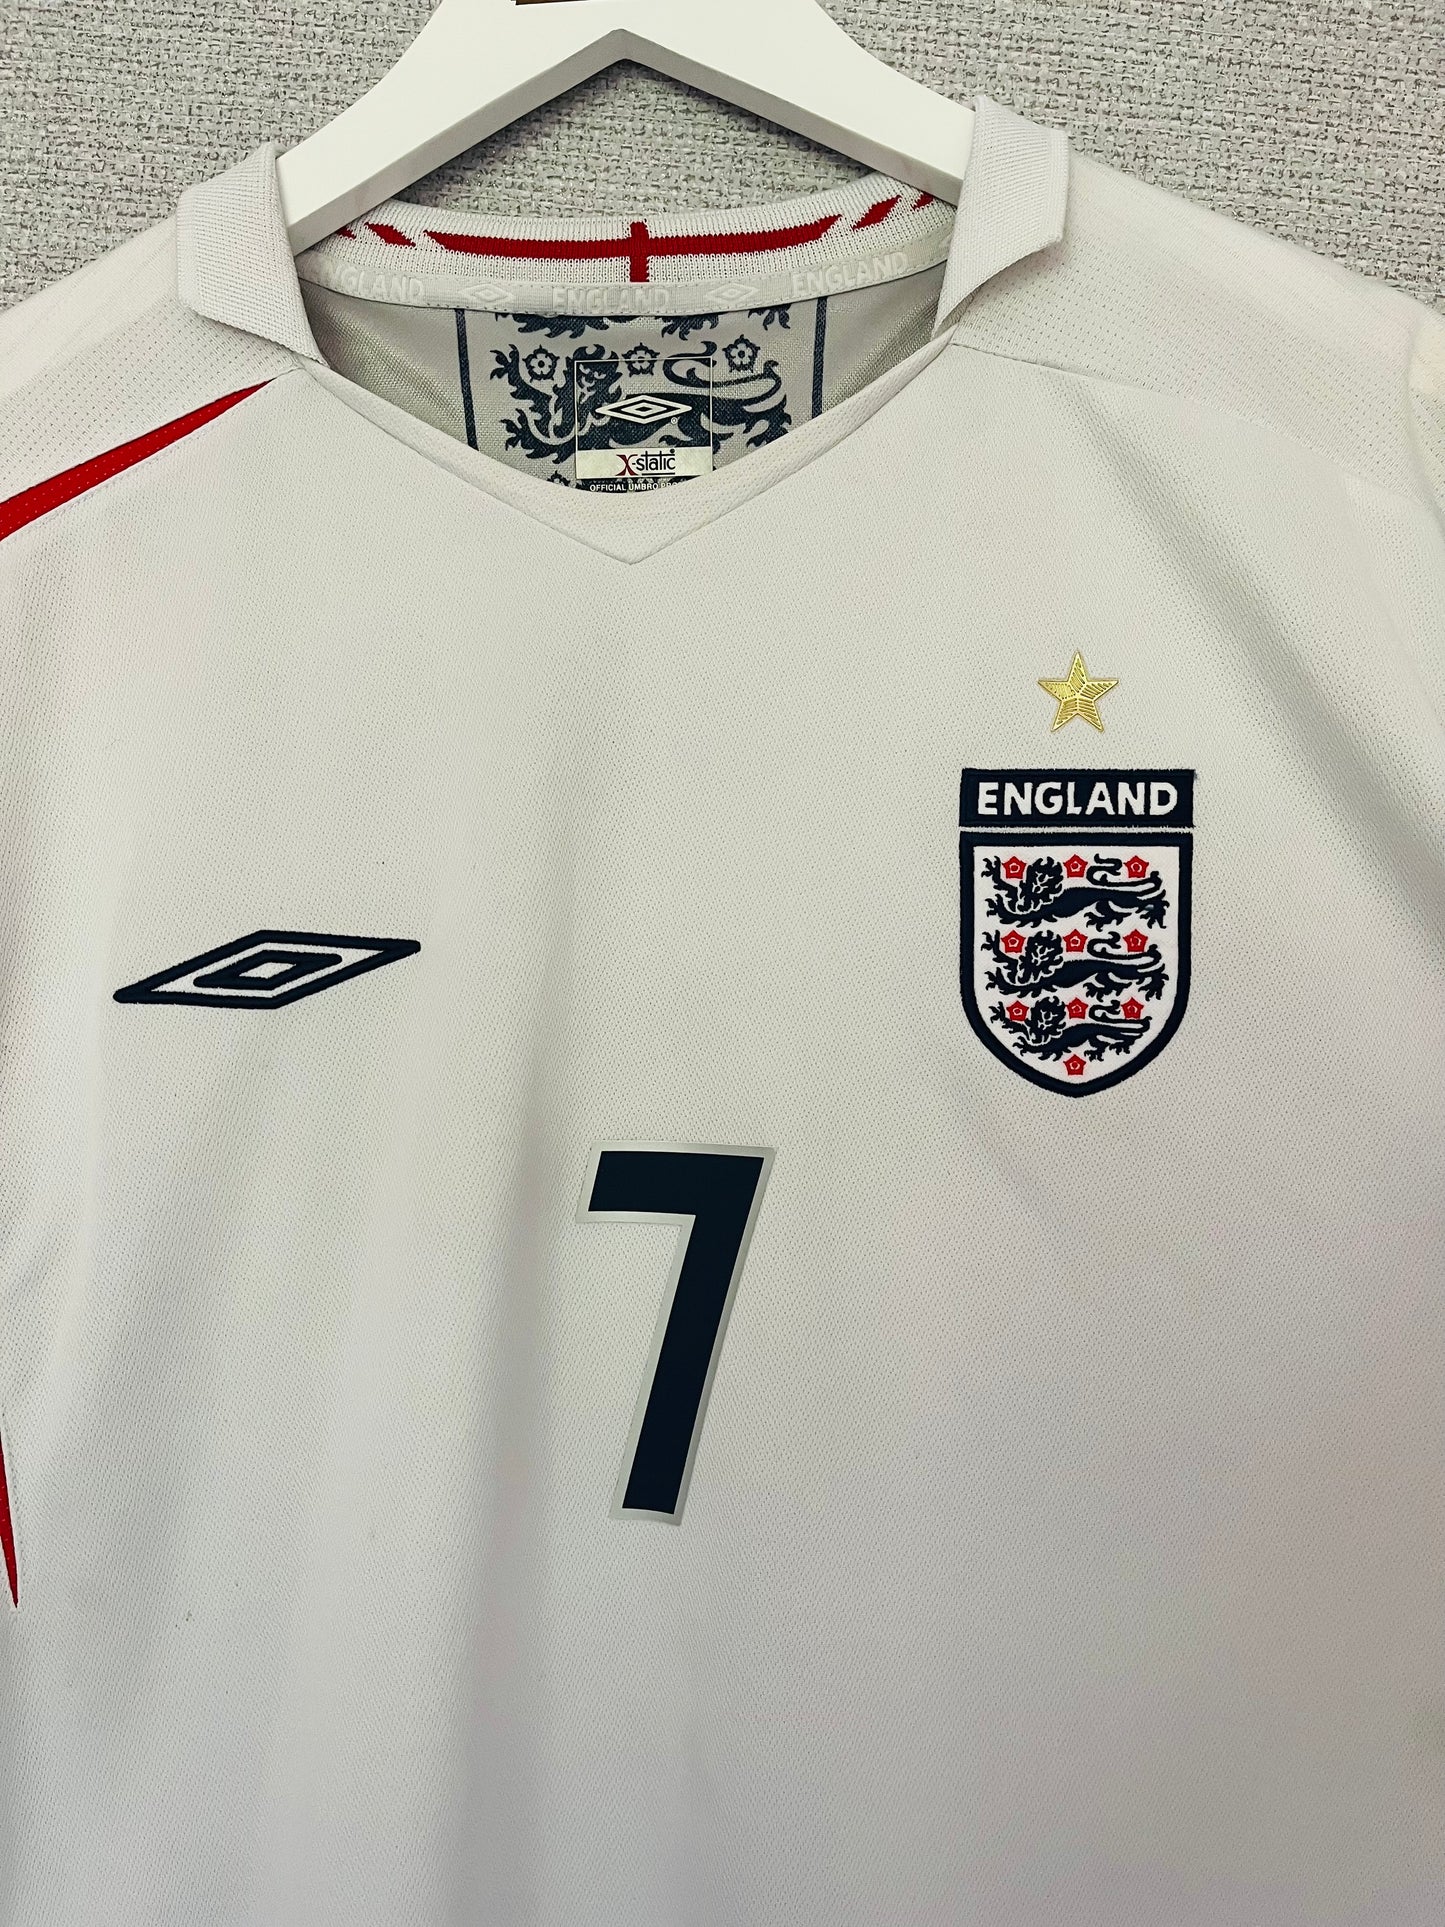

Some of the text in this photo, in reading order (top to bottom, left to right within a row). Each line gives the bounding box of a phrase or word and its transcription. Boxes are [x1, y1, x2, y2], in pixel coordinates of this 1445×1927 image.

[552, 288, 670, 313] ENGLAND
[791, 251, 909, 297] ENGLAND
[615, 449, 676, 476] X-static
[589, 484, 627, 492] OFFICIAL
[628, 482, 659, 491] UMBRO
[977, 781, 1179, 816] ENGLAND
[586, 1149, 766, 1516] 7
